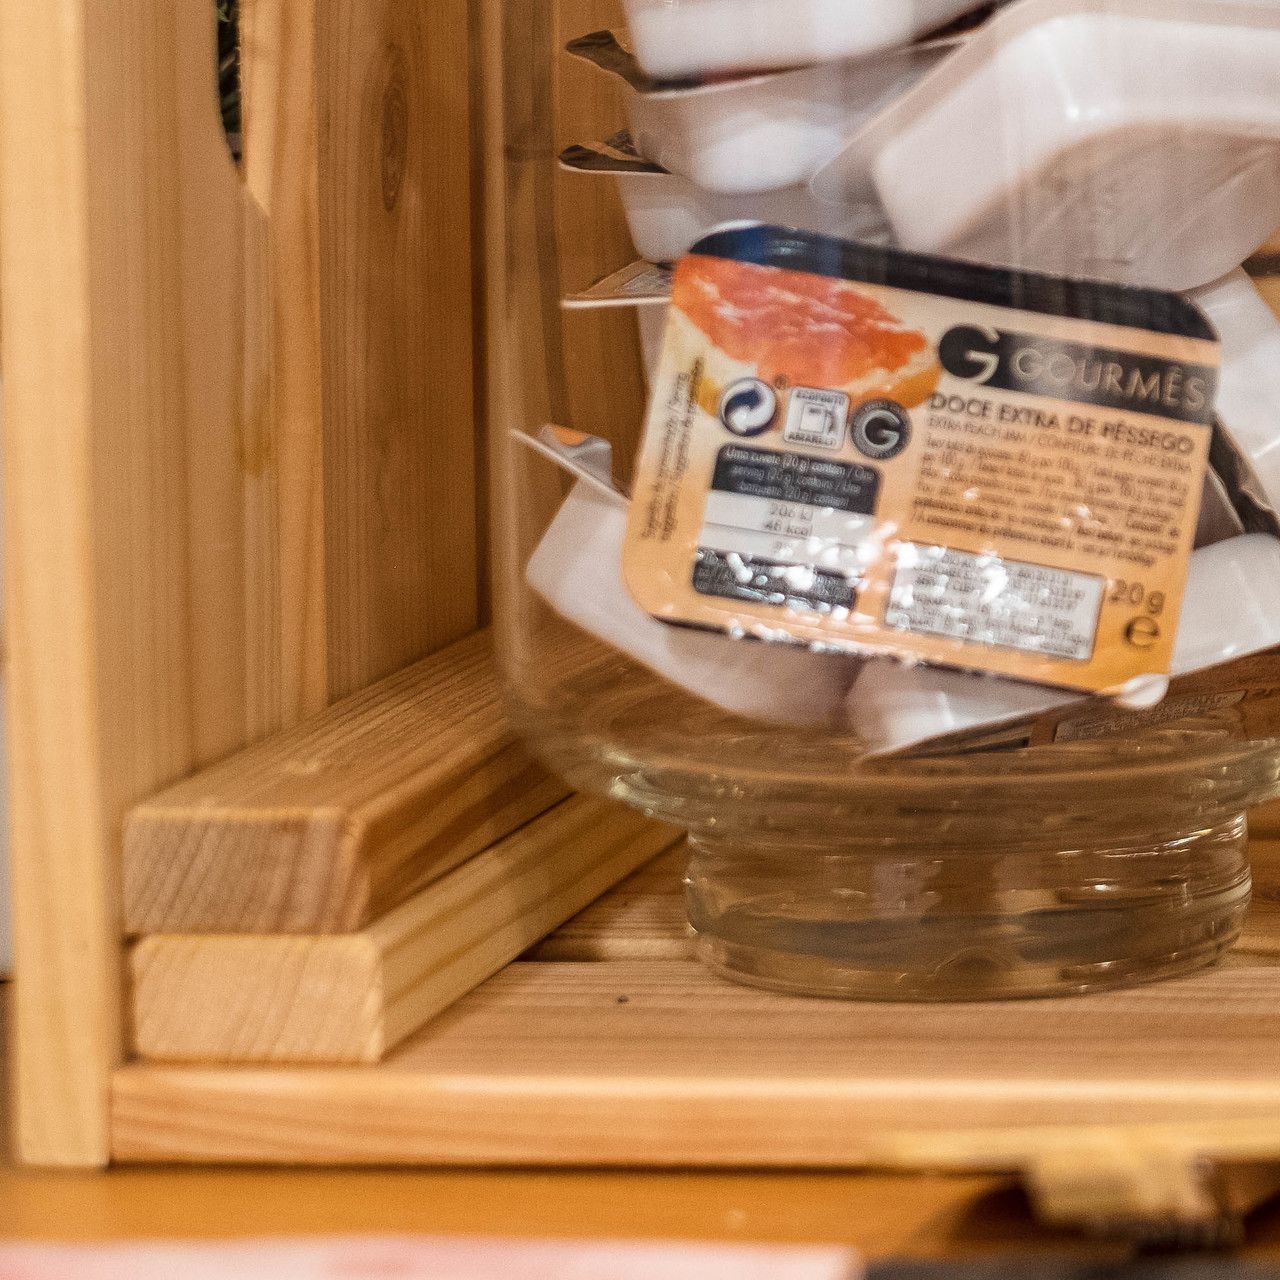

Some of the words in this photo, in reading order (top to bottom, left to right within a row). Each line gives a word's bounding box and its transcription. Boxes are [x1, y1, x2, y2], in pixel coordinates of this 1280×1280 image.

[1011, 346, 1206, 411] GOURMÊS
[929, 392, 991, 417] DOCE
[999, 403, 1060, 429] EXTRA
[1067, 415, 1094, 436] DE
